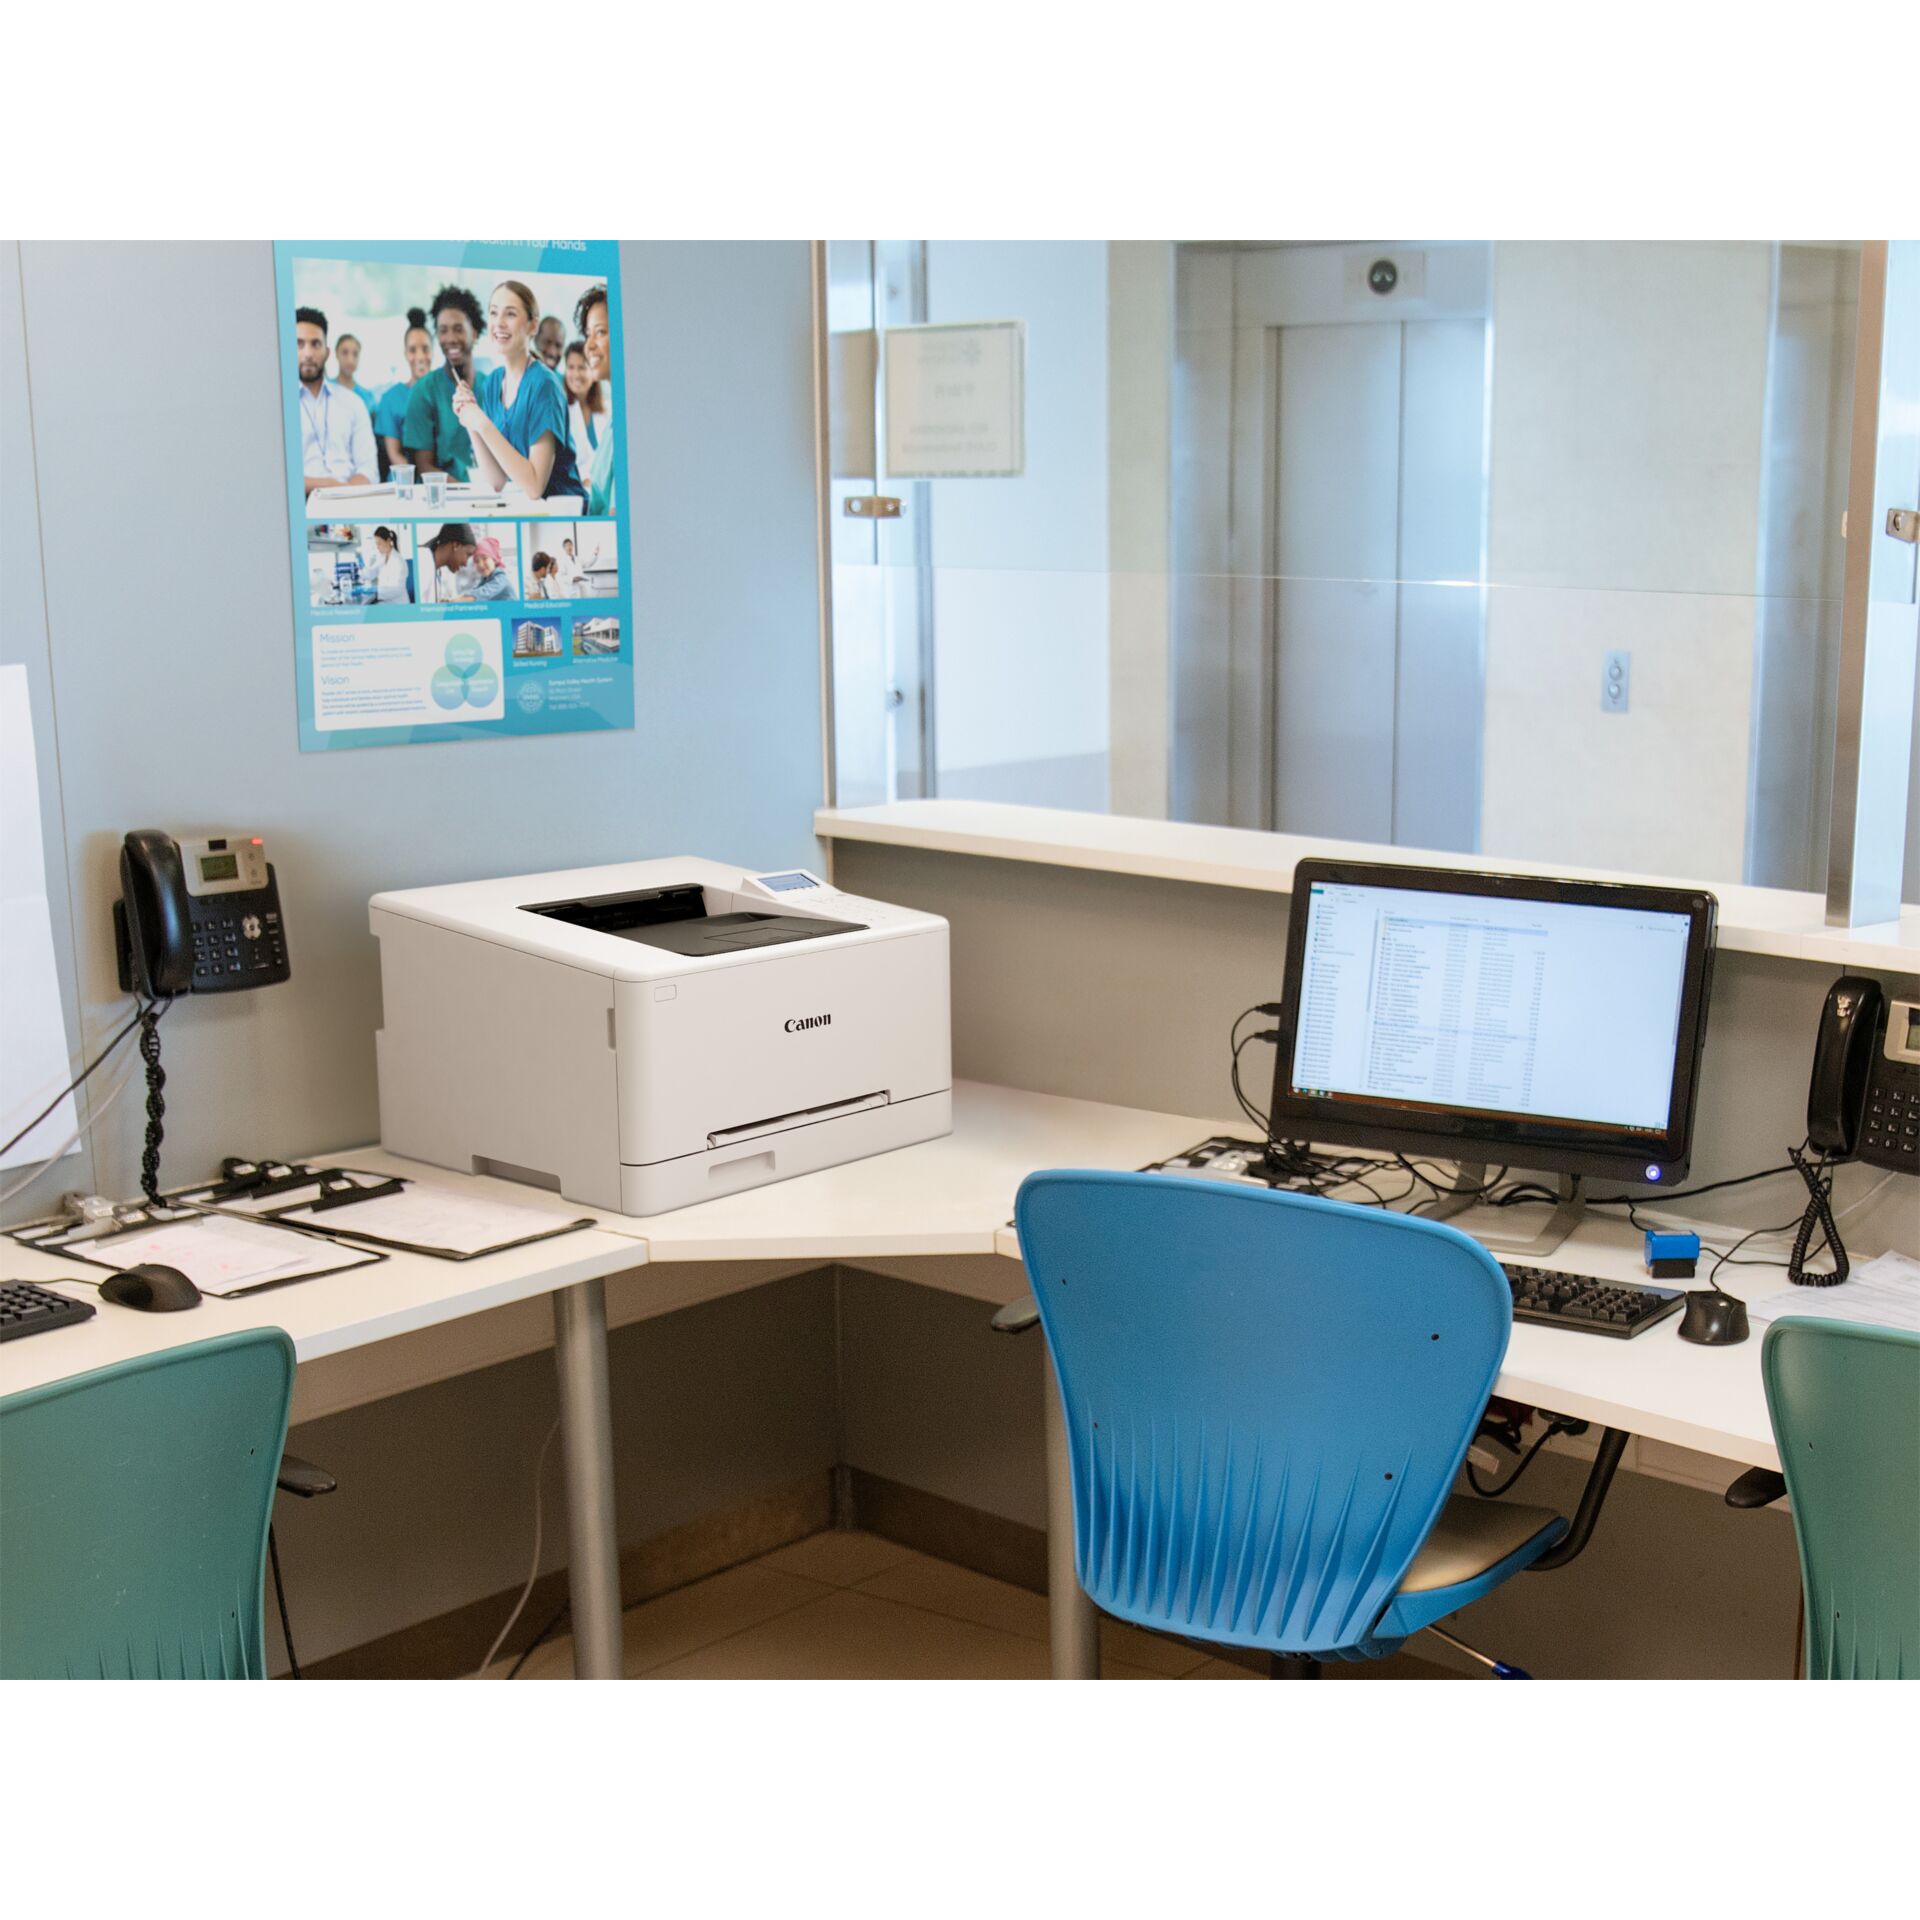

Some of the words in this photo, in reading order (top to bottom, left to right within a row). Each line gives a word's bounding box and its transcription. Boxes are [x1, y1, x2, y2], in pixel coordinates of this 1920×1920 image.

[526, 240, 549, 248] Your
[552, 240, 587, 251] Hands
[319, 633, 355, 643] Mission
[320, 675, 350, 685] Vision
[784, 1013, 831, 1033] Canon
